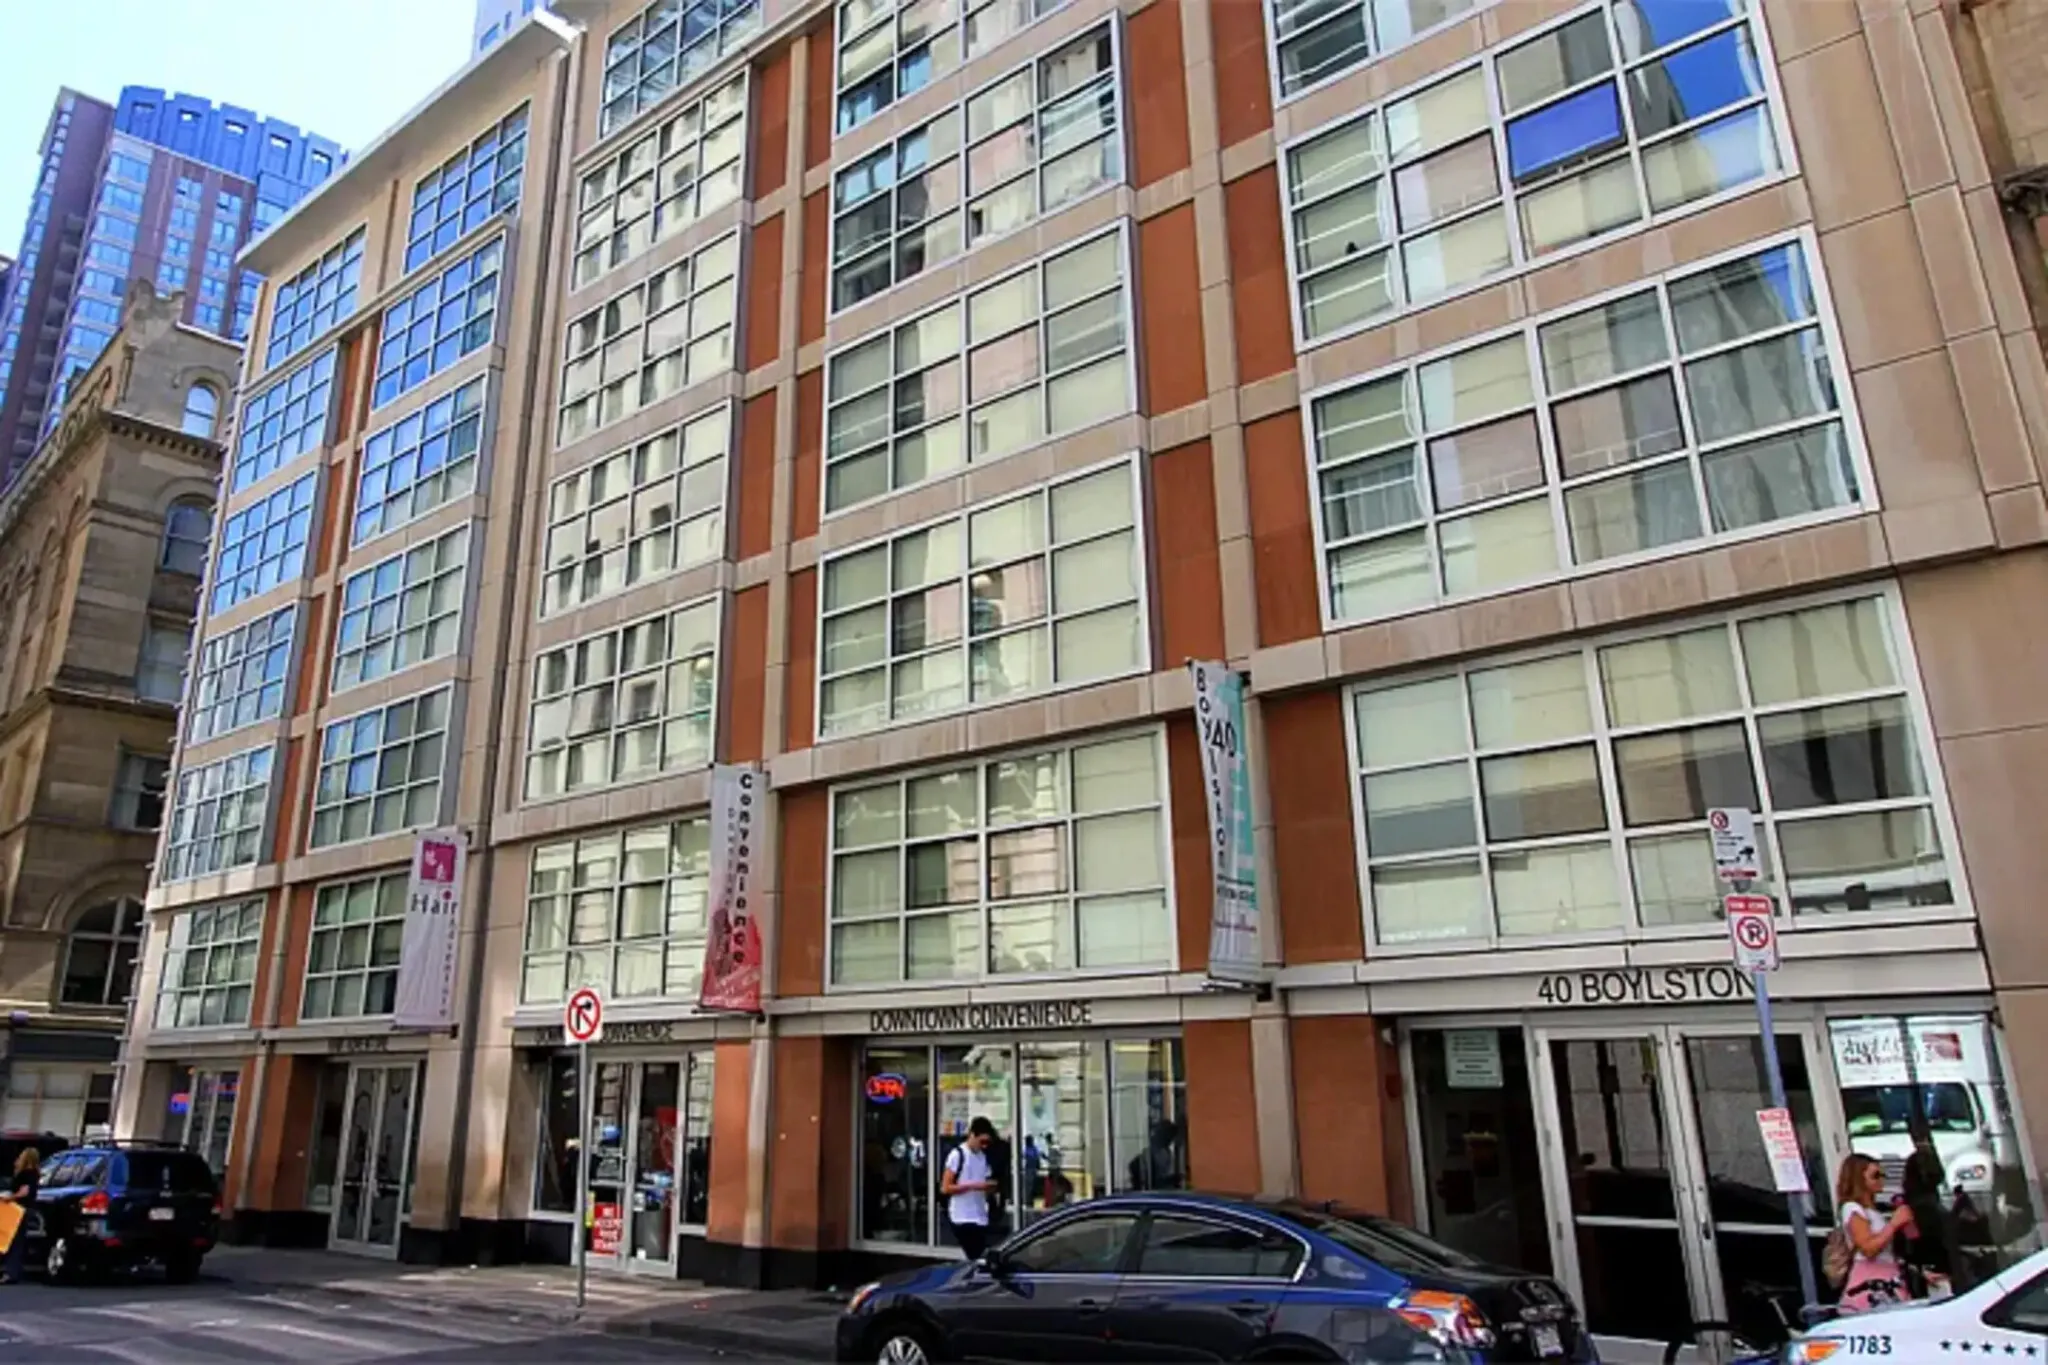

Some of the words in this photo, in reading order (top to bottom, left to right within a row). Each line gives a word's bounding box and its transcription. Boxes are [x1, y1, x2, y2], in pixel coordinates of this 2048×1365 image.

[1211, 719, 1237, 758] 40
[411, 890, 458, 915] Hair
[1538, 975, 1572, 1004] 40
[1580, 966, 1756, 1002] BOYLSTON
[870, 1007, 965, 1033] DOWNTOWN
[969, 1001, 1093, 1030] CONVENIENCE
[1849, 1334, 1892, 1354] 1783
